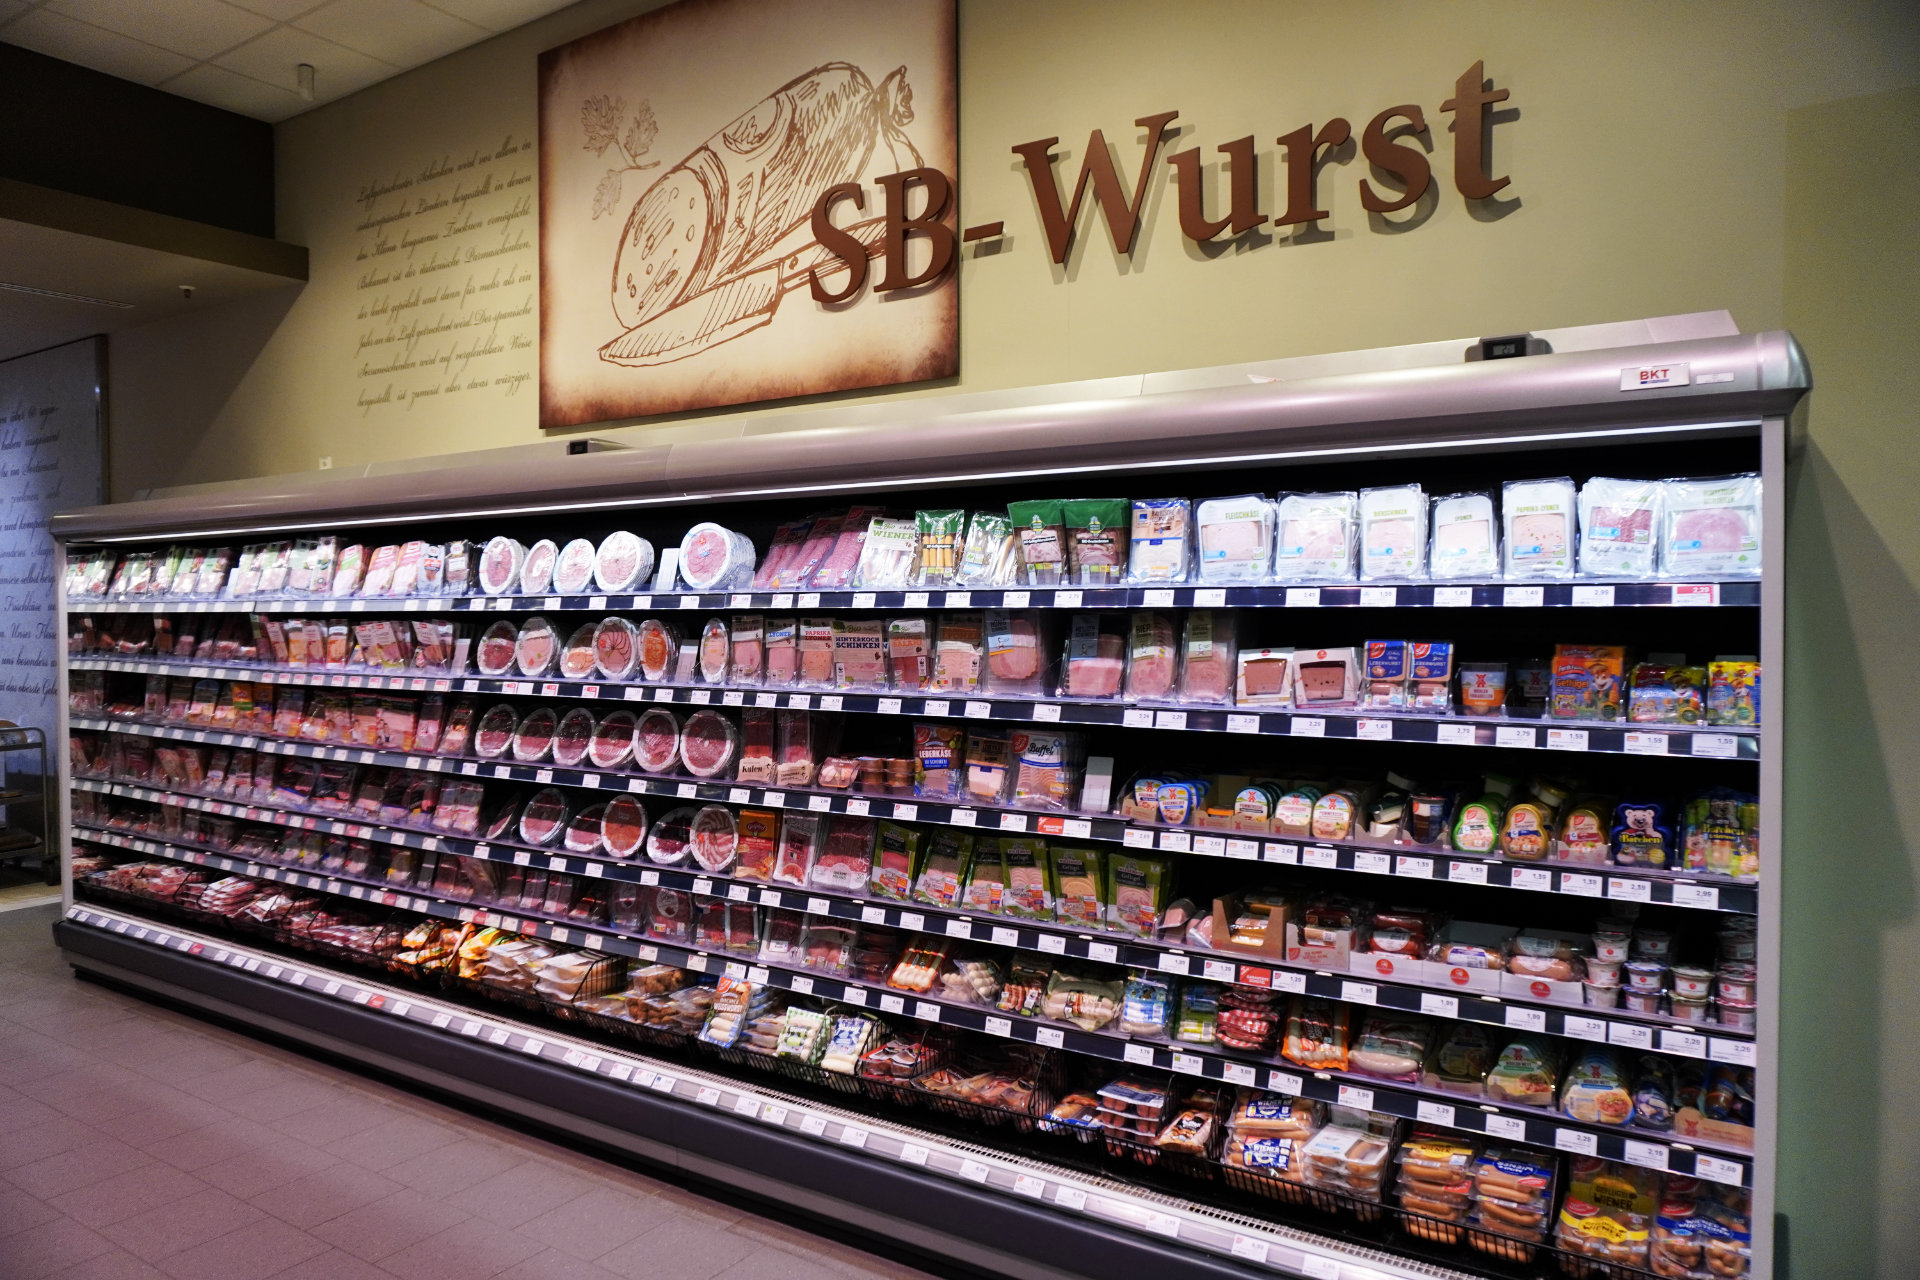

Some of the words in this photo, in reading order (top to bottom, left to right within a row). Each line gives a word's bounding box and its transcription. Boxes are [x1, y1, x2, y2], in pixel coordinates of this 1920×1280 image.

[416, 155, 454, 184] Schinken
[522, 138, 531, 151] in
[495, 180, 504, 192] in
[507, 169, 531, 188] denen
[809, 59, 1511, 305] SB-Wurst
[371, 234, 396, 258] Klima
[400, 228, 438, 260] langsames
[442, 210, 483, 238] Trocknen
[357, 268, 390, 291] Bekannt
[393, 270, 402, 282] ist
[405, 262, 416, 278] der
[420, 246, 461, 275] italienische
[357, 304, 367, 320] der
[370, 295, 389, 317] leicht
[422, 286, 440, 305] und
[441, 284, 460, 301] dann
[460, 273, 475, 310] für
[480, 267, 499, 292] mehr
[503, 263, 516, 287] als
[519, 270, 531, 284] ein
[375, 335, 384, 346] an
[385, 328, 395, 343] der
[397, 318, 418, 352] Luft
[474, 308, 493, 326] Der
[493, 294, 532, 334] spanische
[420, 349, 439, 367] wird
[440, 341, 458, 375] auf
[456, 334, 504, 372] vergleichbare
[511, 333, 532, 351] Weise
[1640, 369, 1670, 381] BKT
[397, 389, 407, 401] ist
[407, 383, 440, 412] zumeist
[445, 373, 461, 393] aber
[467, 376, 489, 390] etwas
[873, 530, 914, 541] WIENER
[836, 642, 880, 650] SCHINKEN
[1556, 679, 1589, 690] Geflügel
[919, 748, 952, 759] LEBERKÄSE
[1028, 742, 1055, 757] Buffet
[742, 765, 763, 773] Kulen
[1621, 834, 1663, 844] Bärchen
[1696, 889, 1712, 897] 2.99
[1586, 1021, 1601, 1029] 2.29
[1631, 1028, 1646, 1036] 2.29
[1685, 1037, 1700, 1045] 2.29
[1734, 1044, 1750, 1053] 2.29
[1506, 1120, 1520, 1128] 2.29
[1593, 1193, 1633, 1211] WIENER
[1583, 1224, 1622, 1239] WIENER
